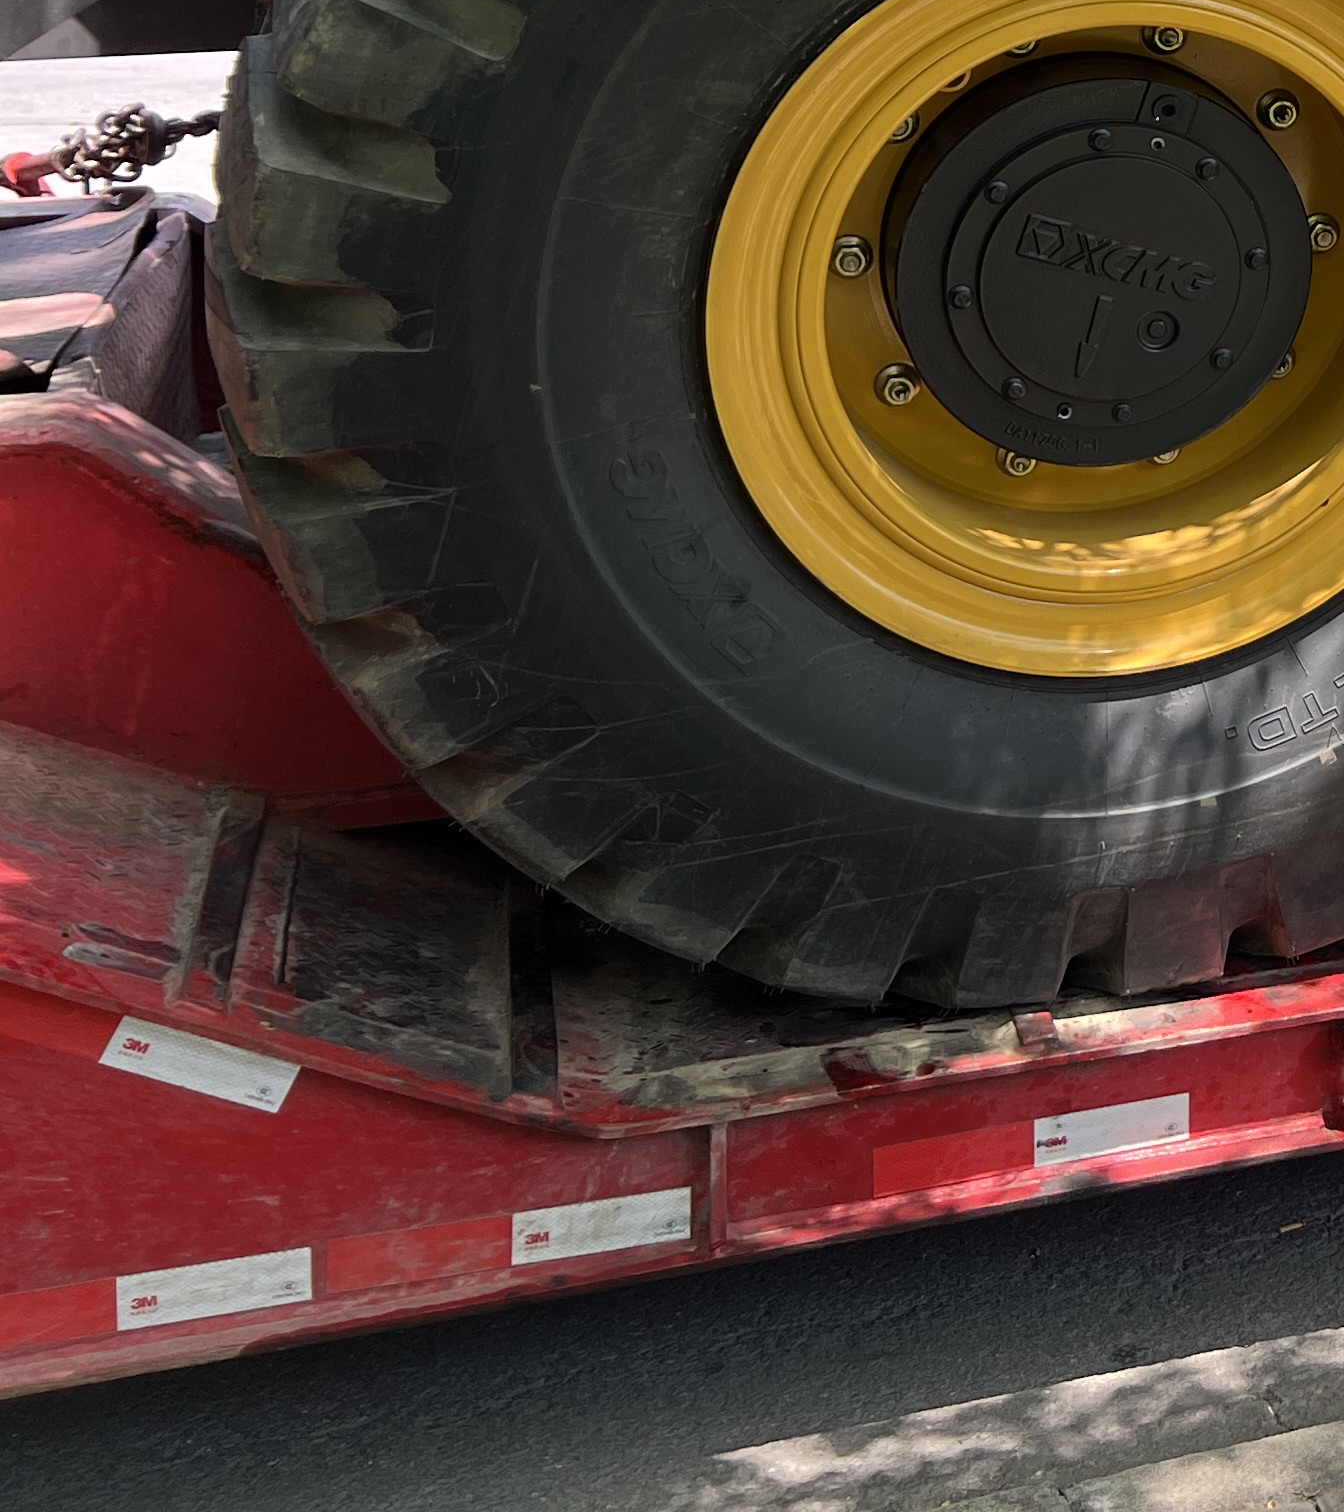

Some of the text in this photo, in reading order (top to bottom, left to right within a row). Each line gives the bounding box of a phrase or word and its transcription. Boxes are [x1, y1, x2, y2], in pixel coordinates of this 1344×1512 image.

[1063, 231, 1217, 301] XCMG
[122, 1037, 151, 1054] 3M
[1045, 1135, 1067, 1148] 3M
[524, 1231, 550, 1245] 3M
[130, 1294, 158, 1310] 3M
